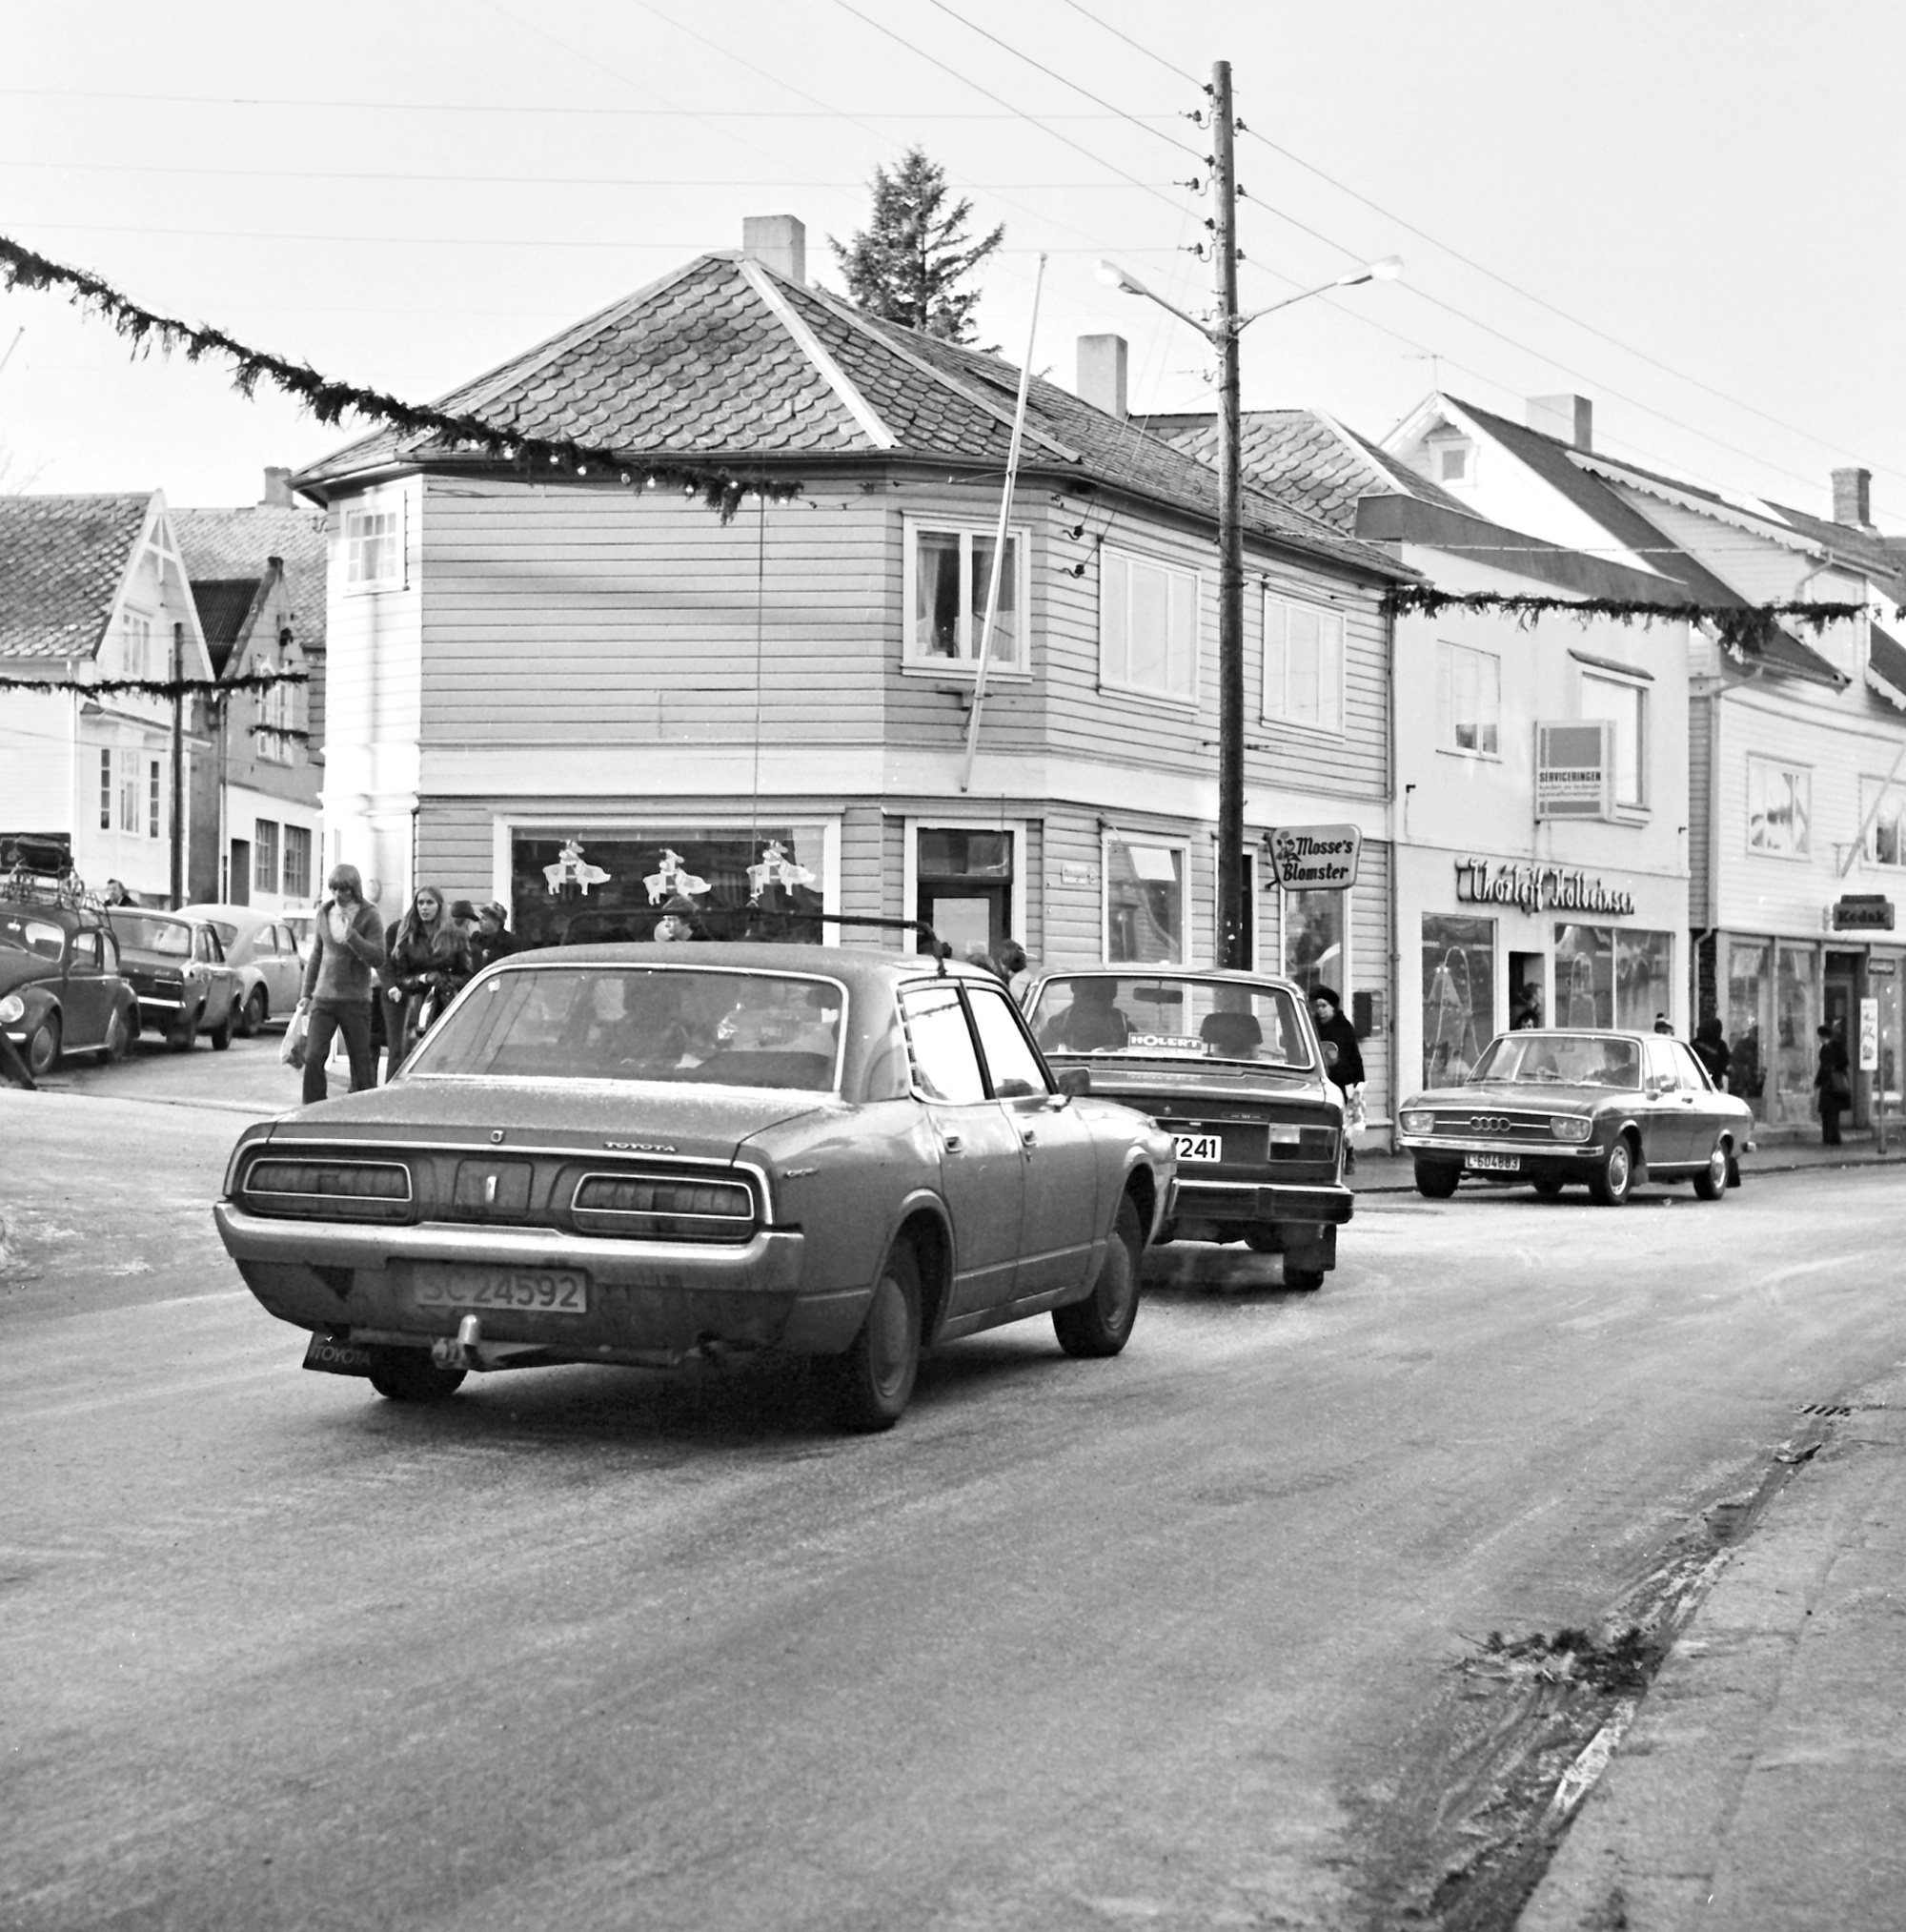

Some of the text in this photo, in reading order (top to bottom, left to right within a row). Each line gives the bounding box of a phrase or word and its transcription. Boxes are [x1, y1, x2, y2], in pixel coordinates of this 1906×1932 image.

[1539, 771, 1601, 783] SERVICERINGEN
[1296, 837, 1353, 856] Mosse's
[1282, 863, 1348, 882] Blomster
[1469, 858, 1544, 911] Thorleif
[604, 1141, 677, 1153] TOYOTA
[314, 1344, 371, 1366] TOYOTA
